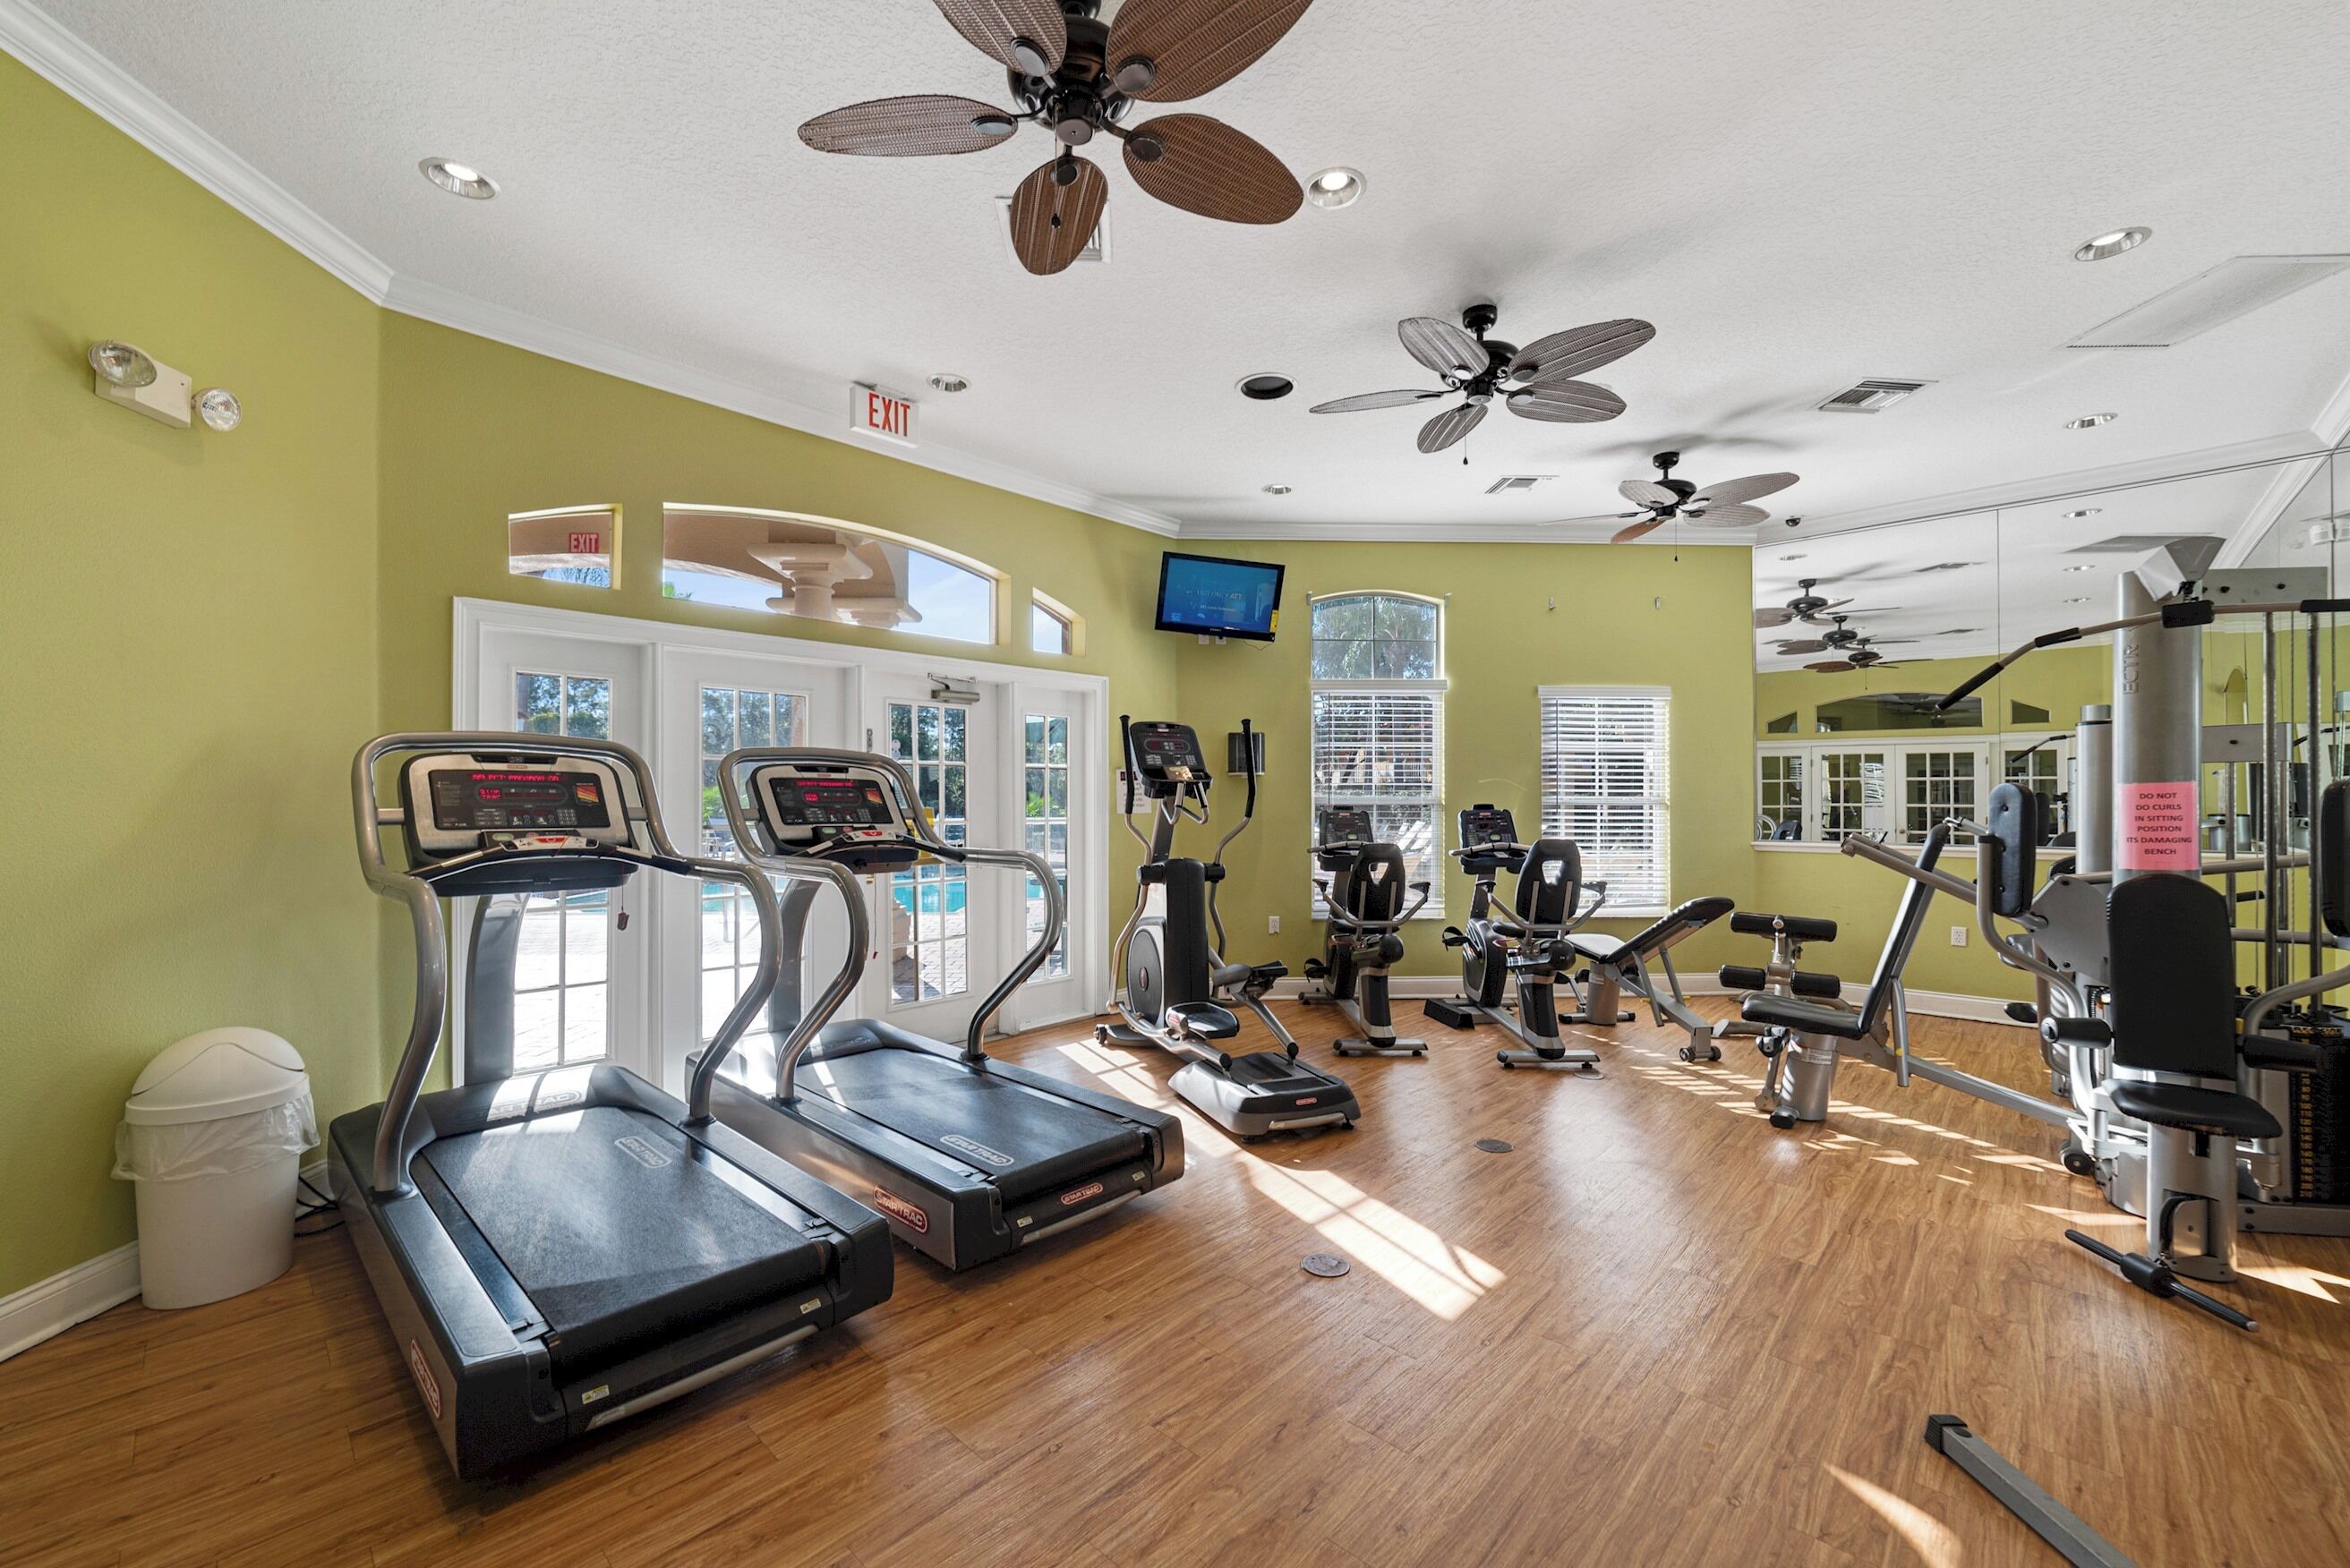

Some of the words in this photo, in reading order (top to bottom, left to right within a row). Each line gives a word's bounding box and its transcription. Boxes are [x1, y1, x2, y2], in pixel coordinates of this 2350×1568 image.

[868, 392, 910, 437] EXIT
[570, 533, 598, 553] EXIT
[876, 1193, 898, 1212] STAR
[898, 1206, 923, 1226] TRAC
